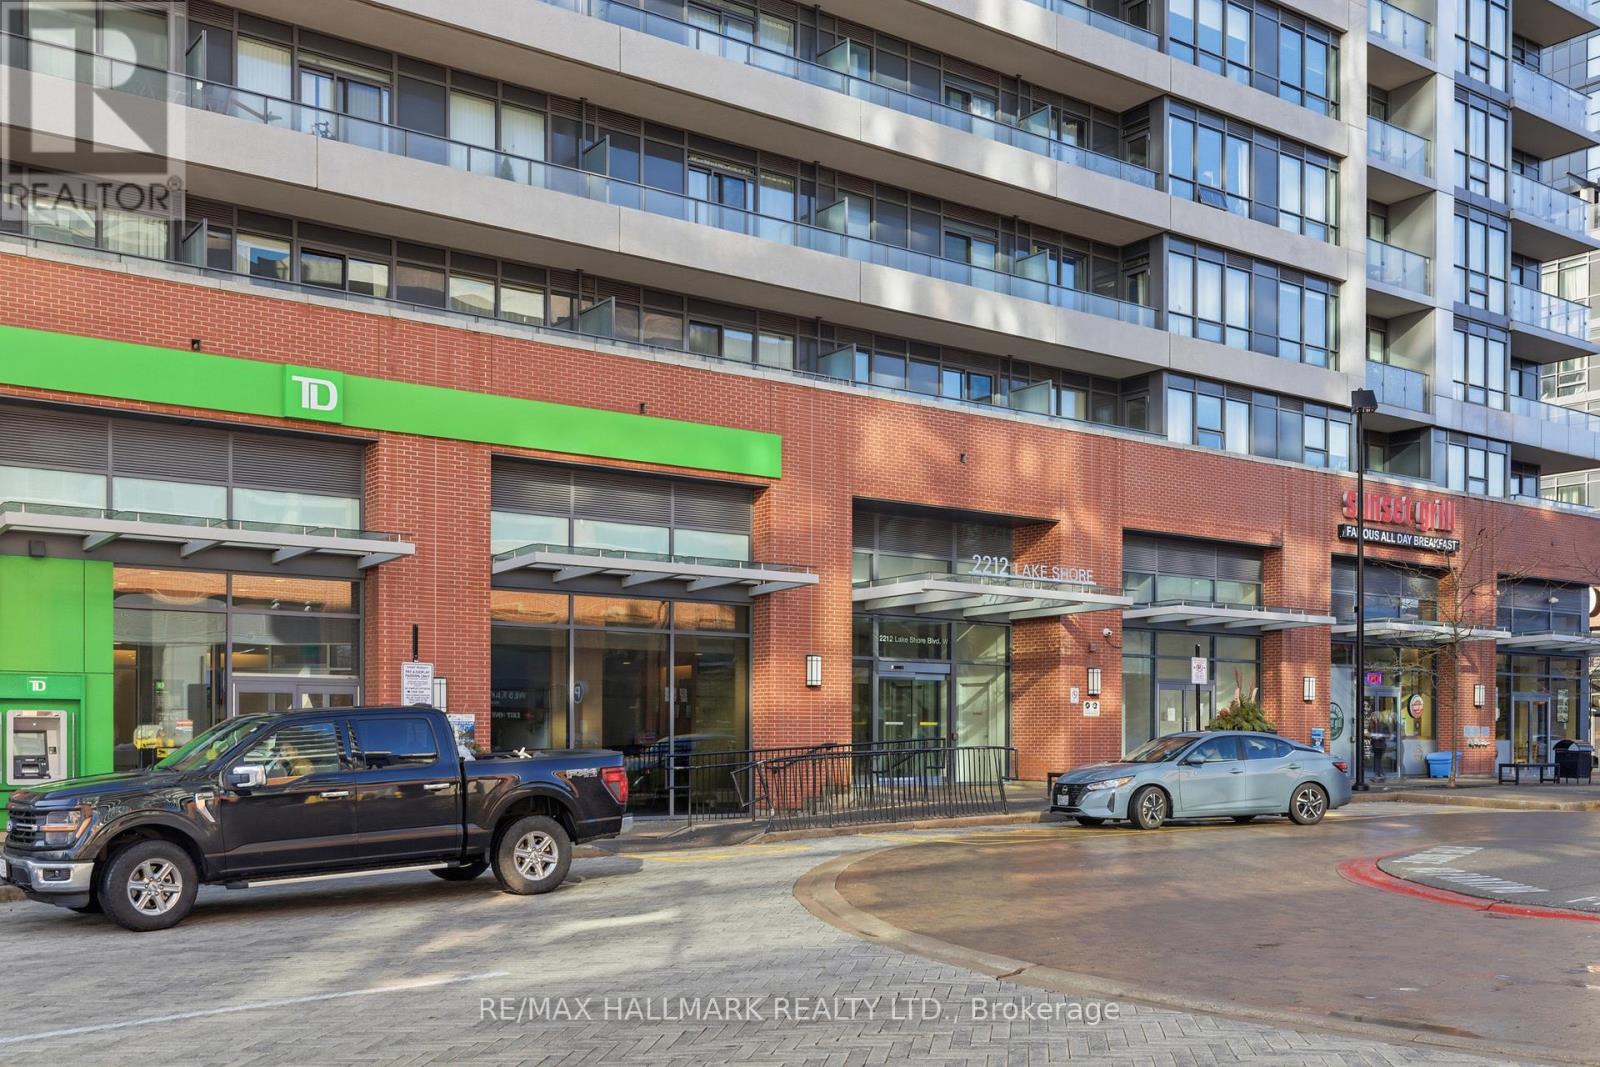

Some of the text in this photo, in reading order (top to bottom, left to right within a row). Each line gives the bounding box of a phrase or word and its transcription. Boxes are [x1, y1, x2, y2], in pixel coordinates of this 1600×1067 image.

[291, 375, 338, 412] TD
[1415, 496, 1456, 532] grill
[1346, 526, 1457, 550] FAOUS ALL DAY BREAKFAST
[971, 554, 1093, 584] 2212 LAKE SHORE
[879, 634, 893, 643] 2212
[894, 635, 908, 644] Lake
[909, 636, 926, 646] Shore
[28, 680, 46, 692] TD
